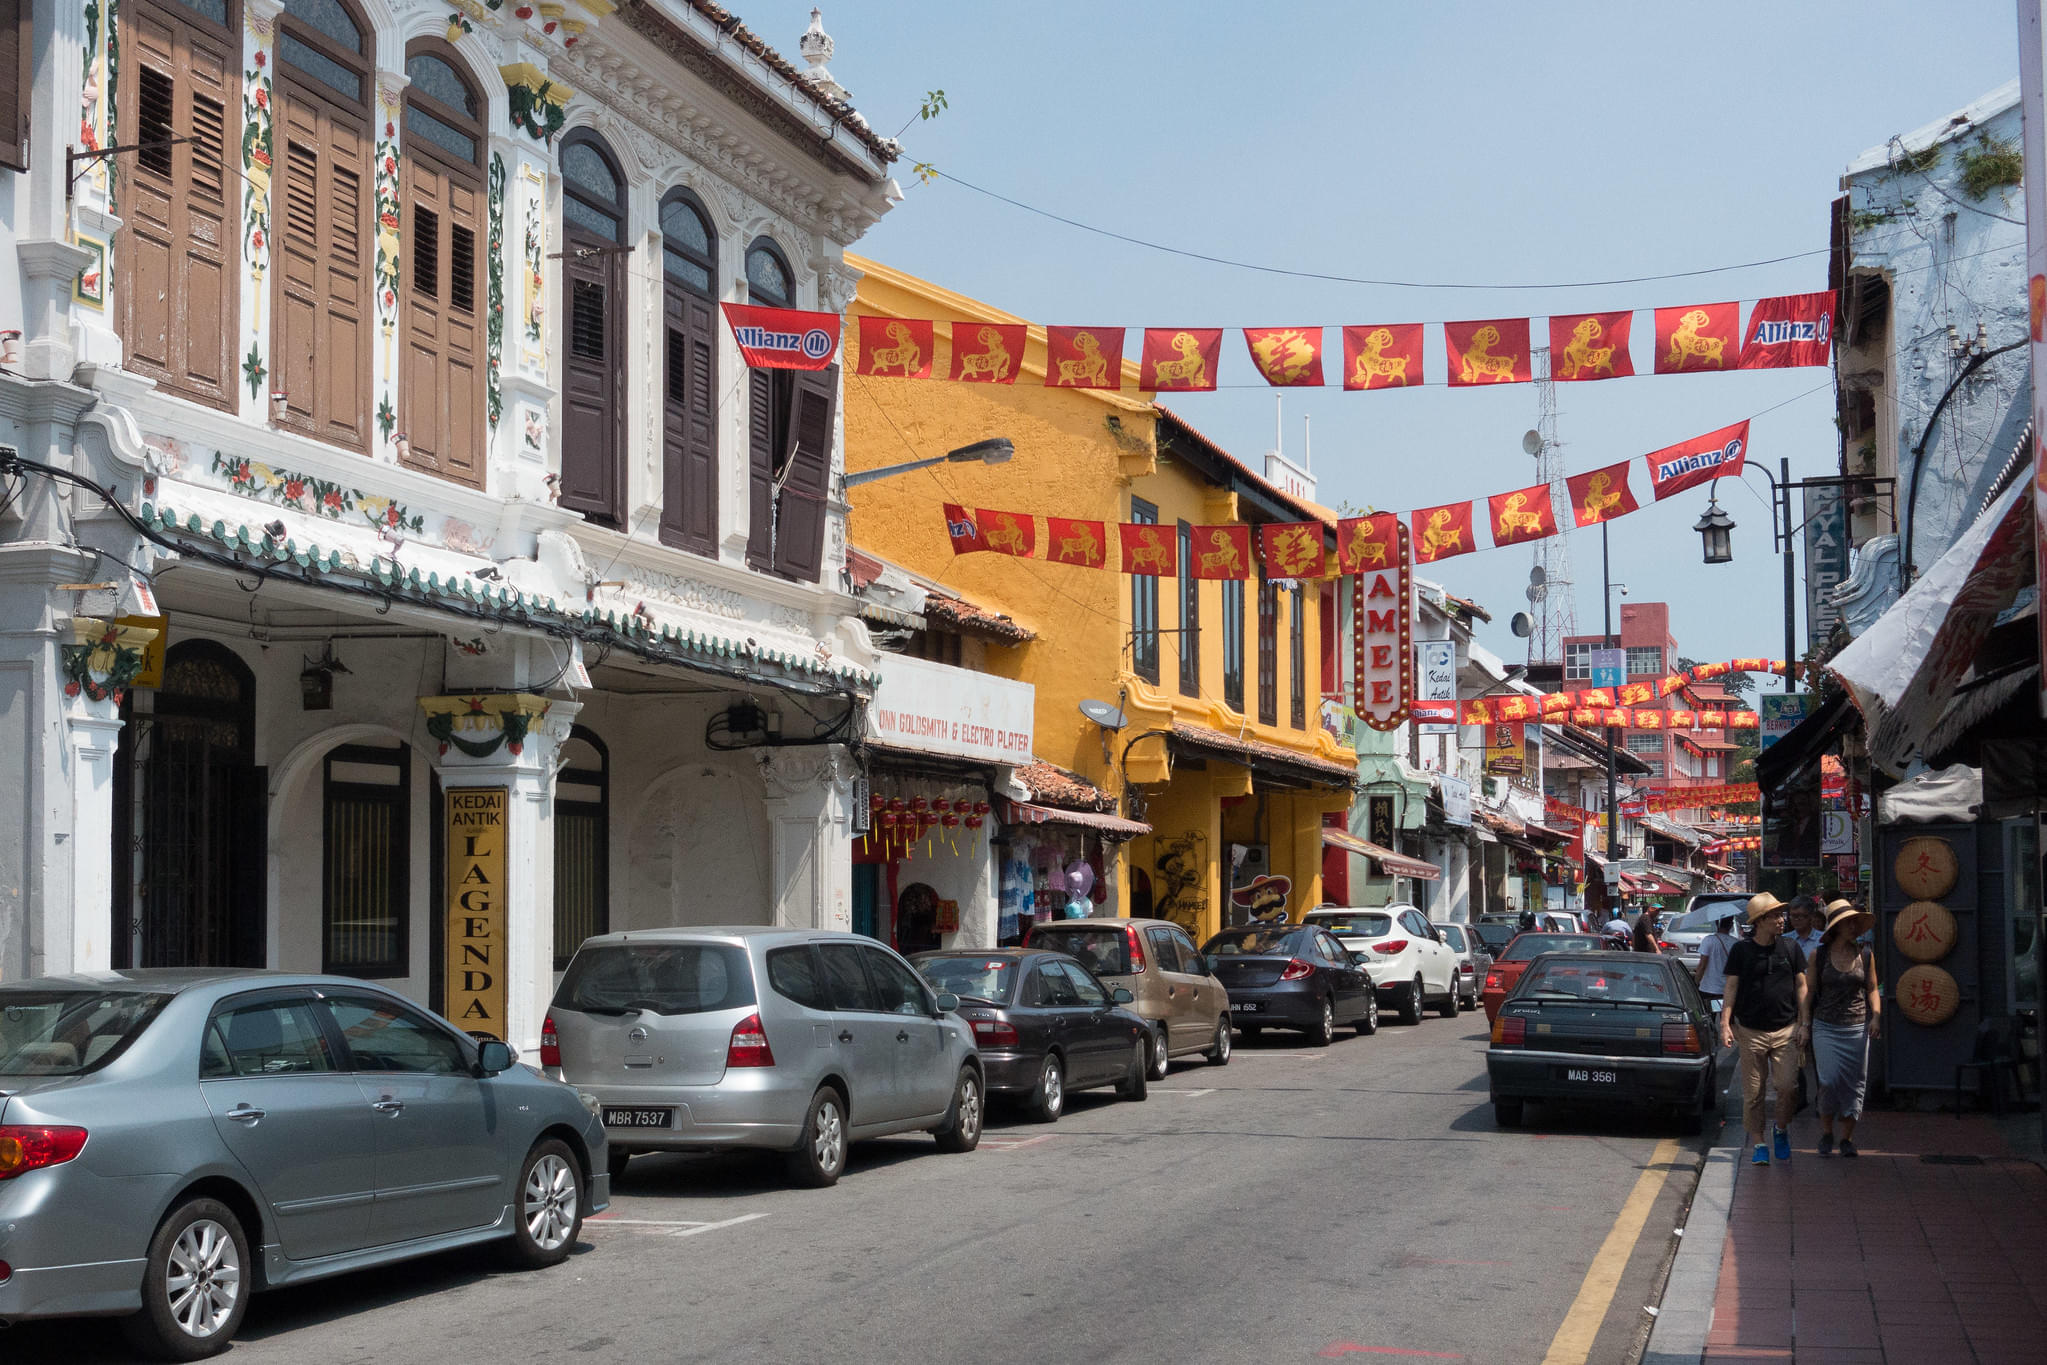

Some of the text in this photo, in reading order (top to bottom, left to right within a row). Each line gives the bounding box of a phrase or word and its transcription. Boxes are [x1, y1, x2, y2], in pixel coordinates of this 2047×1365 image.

[1753, 321, 1815, 344] Allinz
[1659, 449, 1722, 481] Allianz
[1428, 668, 1451, 684] Kedai
[1429, 687, 1451, 701] Antik
[899, 712, 949, 740] GOLDSMITH
[952, 721, 958, 742] &
[961, 723, 994, 748] ELECTRO
[997, 729, 1029, 753] PLATER
[453, 795, 501, 809] KEDAI
[452, 811, 500, 826] ANTIK
[459, 835, 494, 1020] LAGENDA
[1568, 1069, 1616, 1083] MAB 3561
[608, 1111, 665, 1126] MBR 7537
